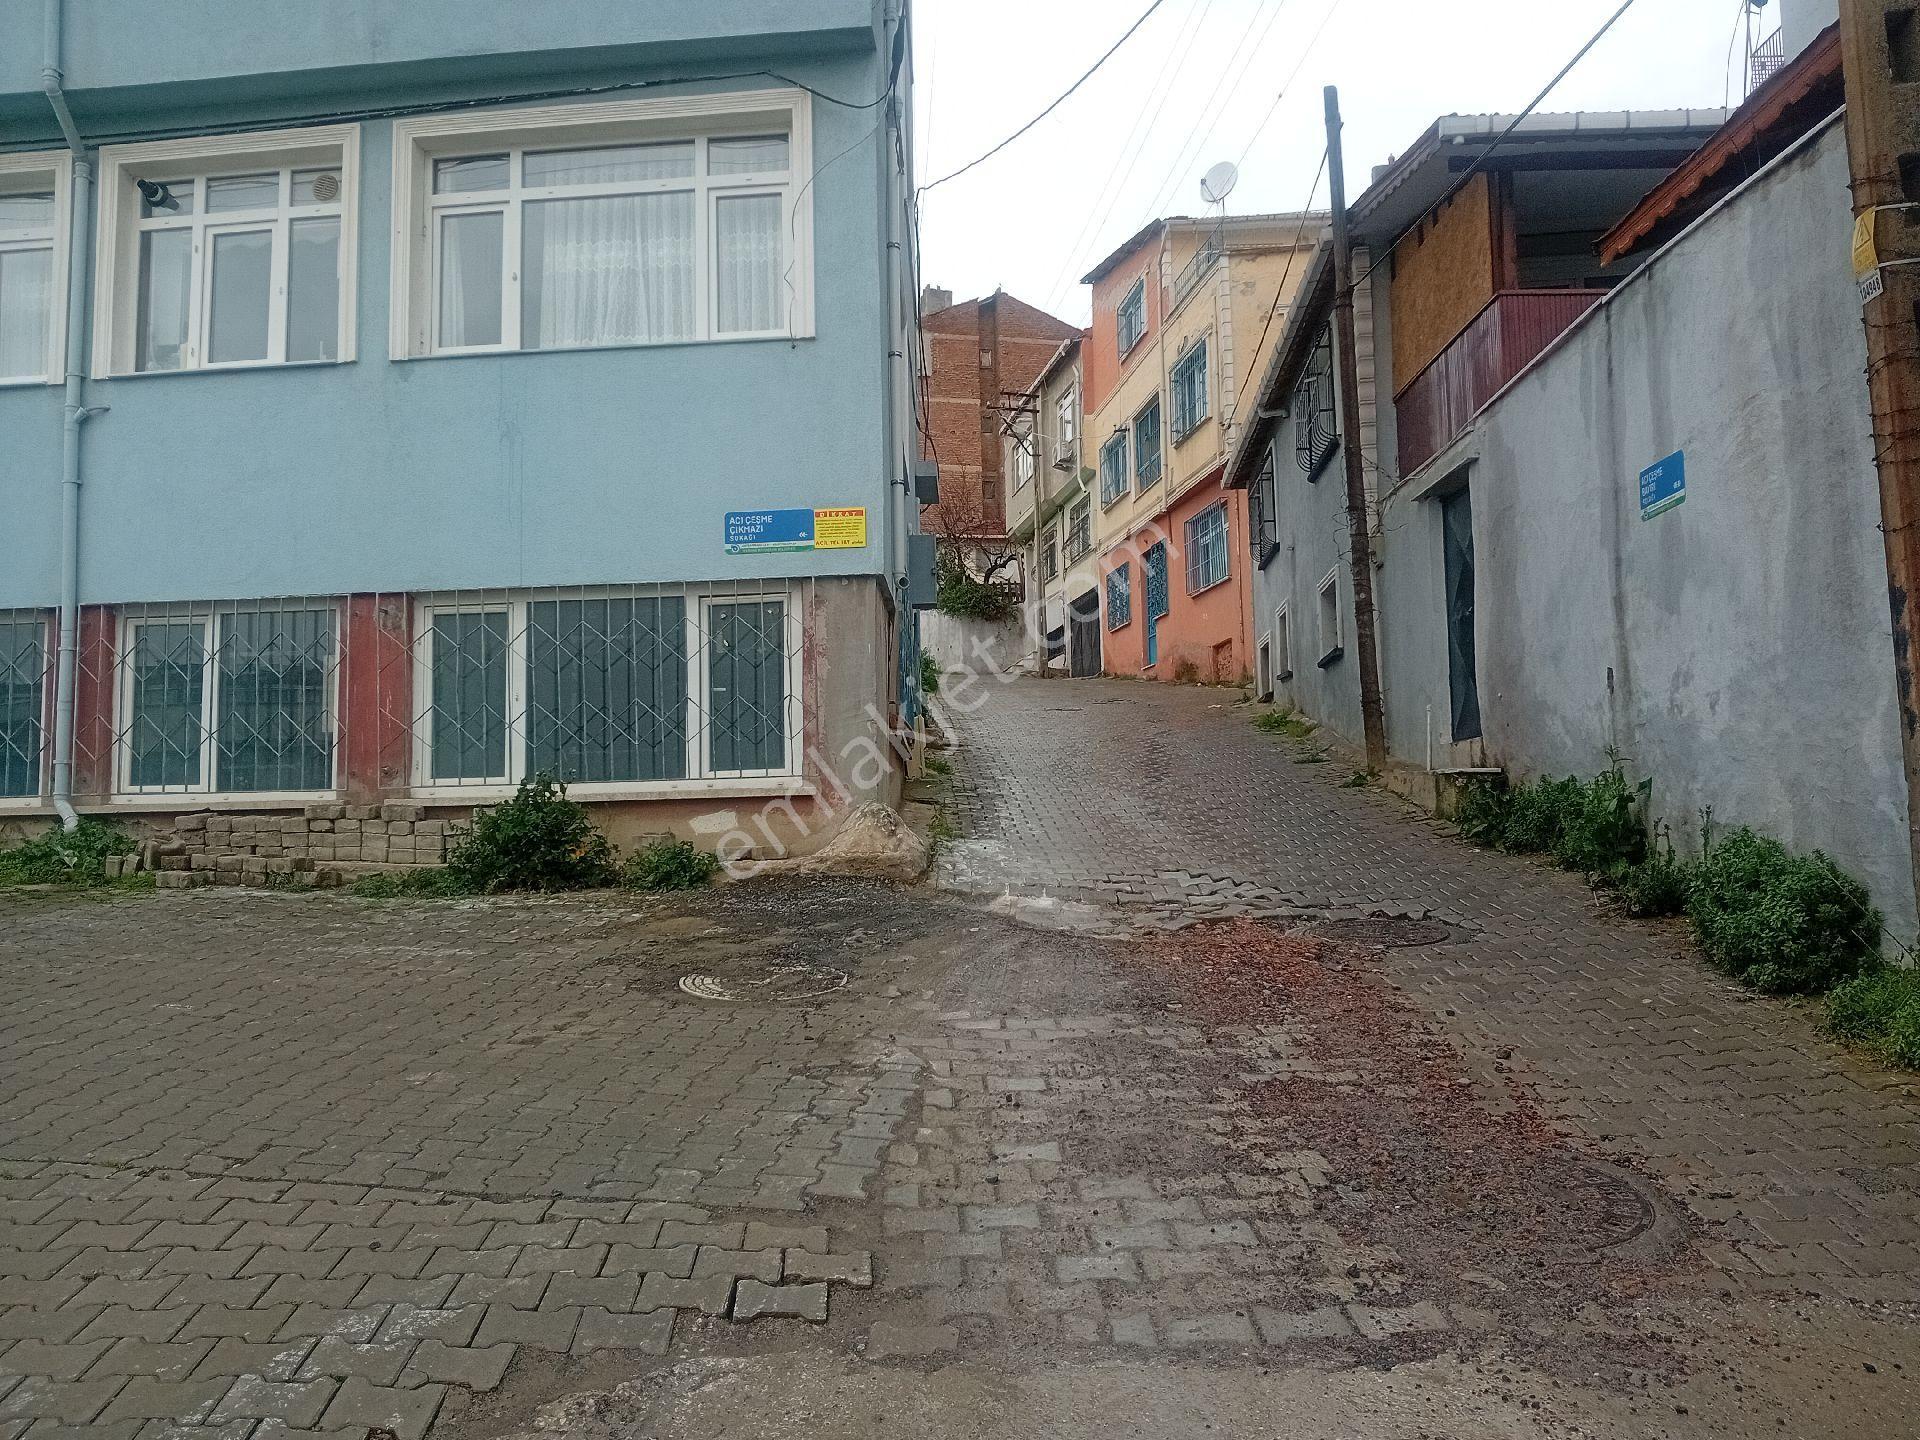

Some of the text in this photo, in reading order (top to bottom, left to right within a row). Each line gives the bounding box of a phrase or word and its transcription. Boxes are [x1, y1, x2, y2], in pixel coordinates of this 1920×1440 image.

[729, 515, 773, 525] ACI ÇEŞME
[729, 525, 764, 535] ÇIKMAZI
